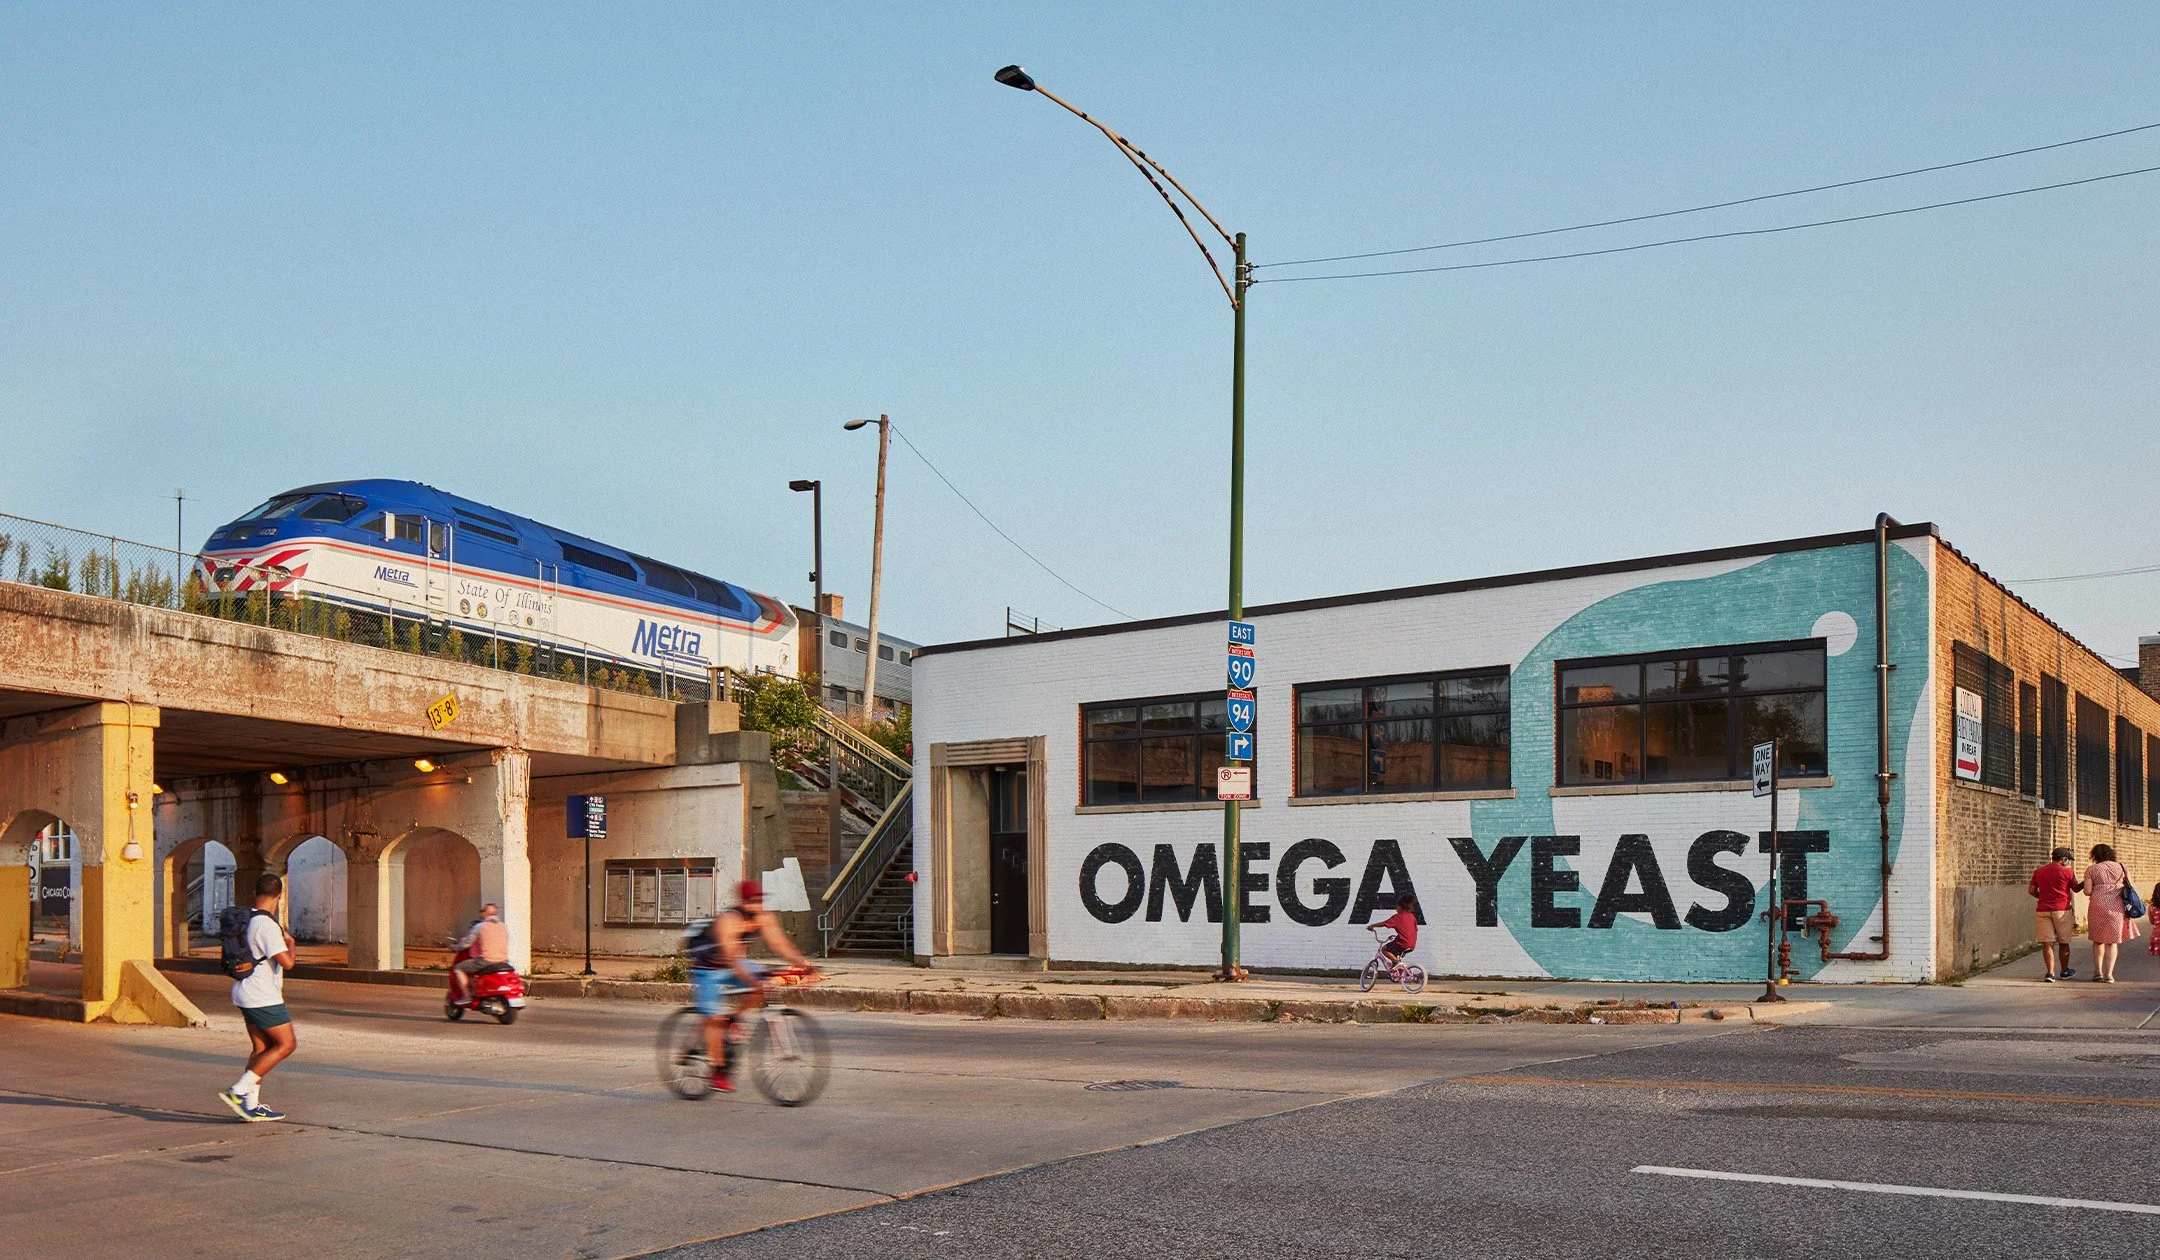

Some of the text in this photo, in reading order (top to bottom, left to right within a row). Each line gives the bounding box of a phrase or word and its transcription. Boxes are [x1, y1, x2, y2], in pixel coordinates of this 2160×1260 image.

[374, 565, 410, 583] Metra
[458, 579, 552, 615] State Of Illinois
[631, 618, 702, 659] Metra
[1232, 625, 1252, 641] EAST
[1231, 660, 1252, 682] 90
[1232, 703, 1250, 724] 94
[1755, 747, 1771, 762] ONE
[1961, 742, 1977, 756] IN REAR
[1755, 761, 1771, 776] WAY
[1079, 829, 1829, 932] OMEGA YEAST
